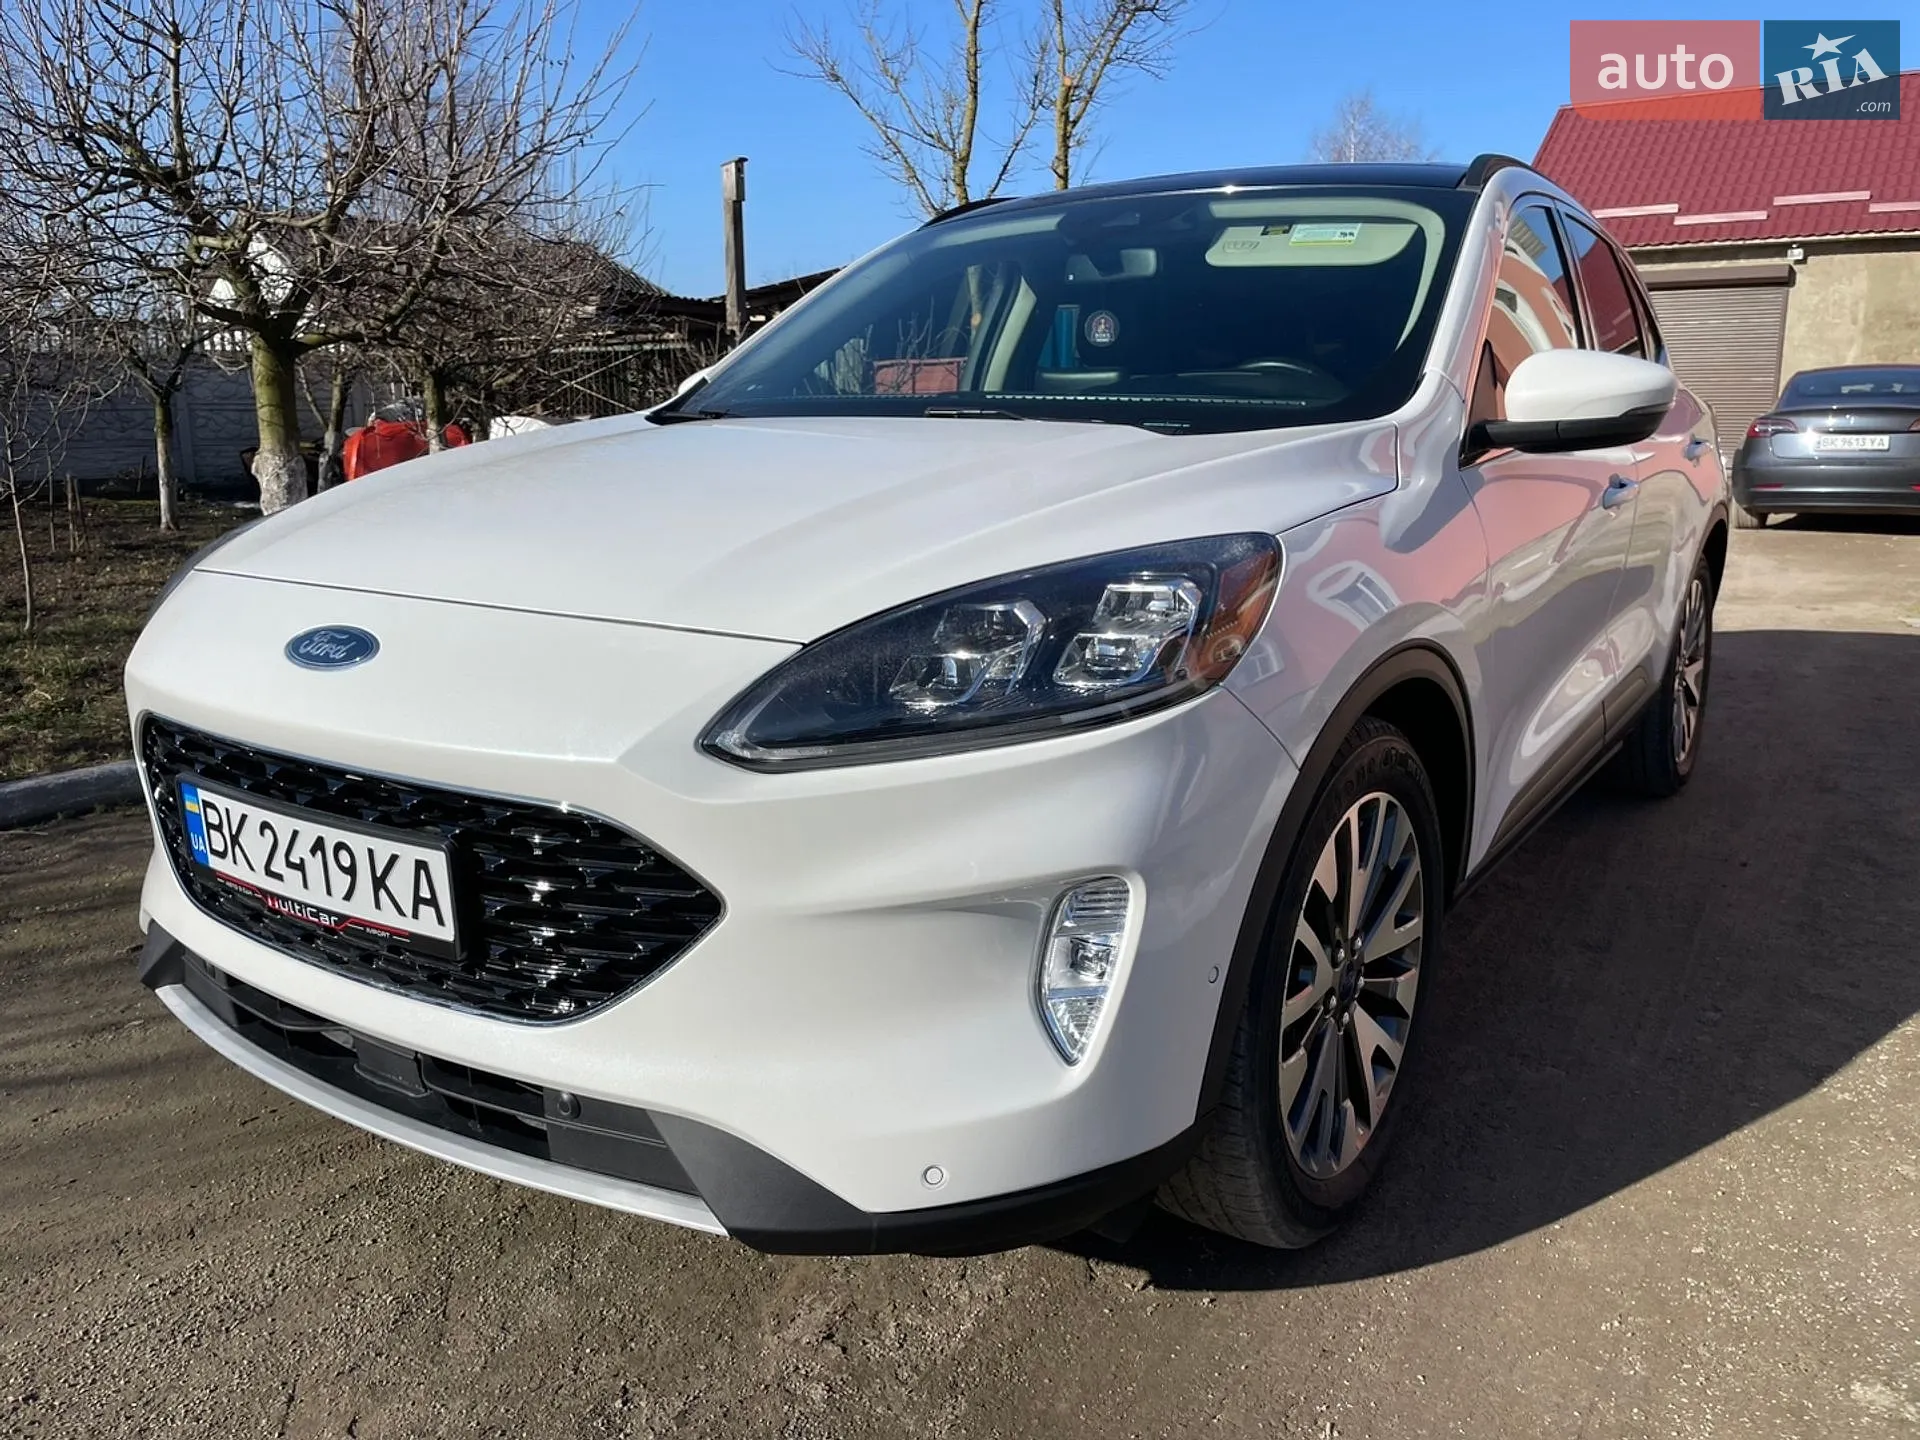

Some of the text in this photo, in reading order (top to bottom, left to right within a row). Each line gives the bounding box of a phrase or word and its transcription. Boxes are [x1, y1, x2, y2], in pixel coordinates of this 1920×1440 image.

[1823, 437, 1885, 447] BK 9613 YA
[299, 630, 357, 660] Ford
[190, 831, 207, 854] UA
[201, 799, 446, 927] BK 2419 KA
